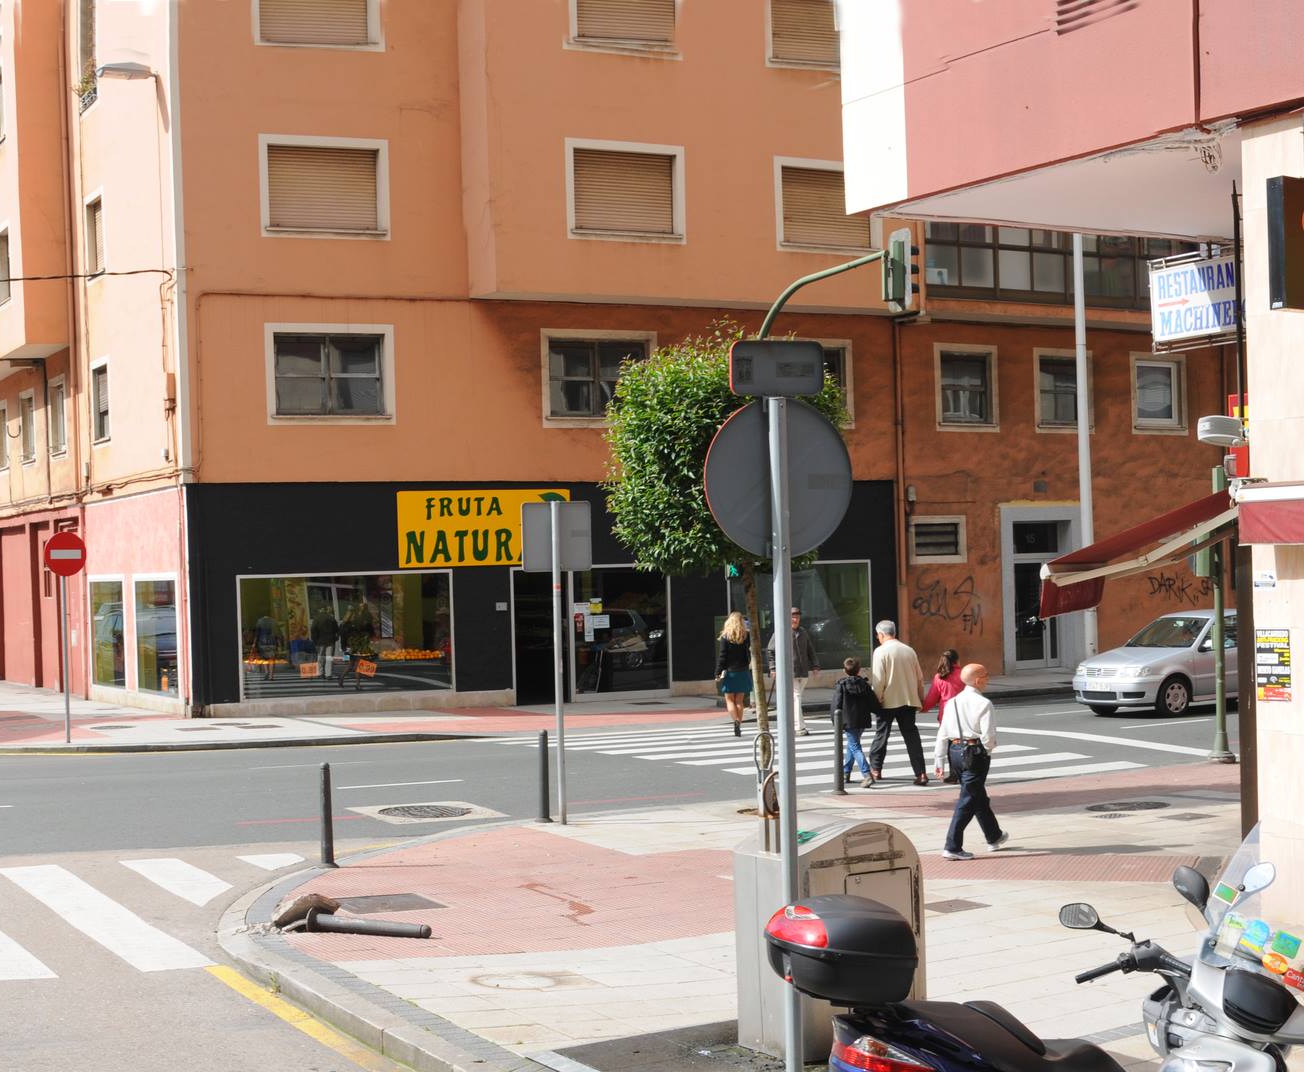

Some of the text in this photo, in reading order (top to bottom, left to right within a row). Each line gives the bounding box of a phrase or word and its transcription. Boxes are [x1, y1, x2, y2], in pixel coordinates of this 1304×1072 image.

[1158, 261, 1237, 299] RESTAURAN
[425, 496, 503, 520] FRUTA
[405, 528, 523, 565] NATUR
